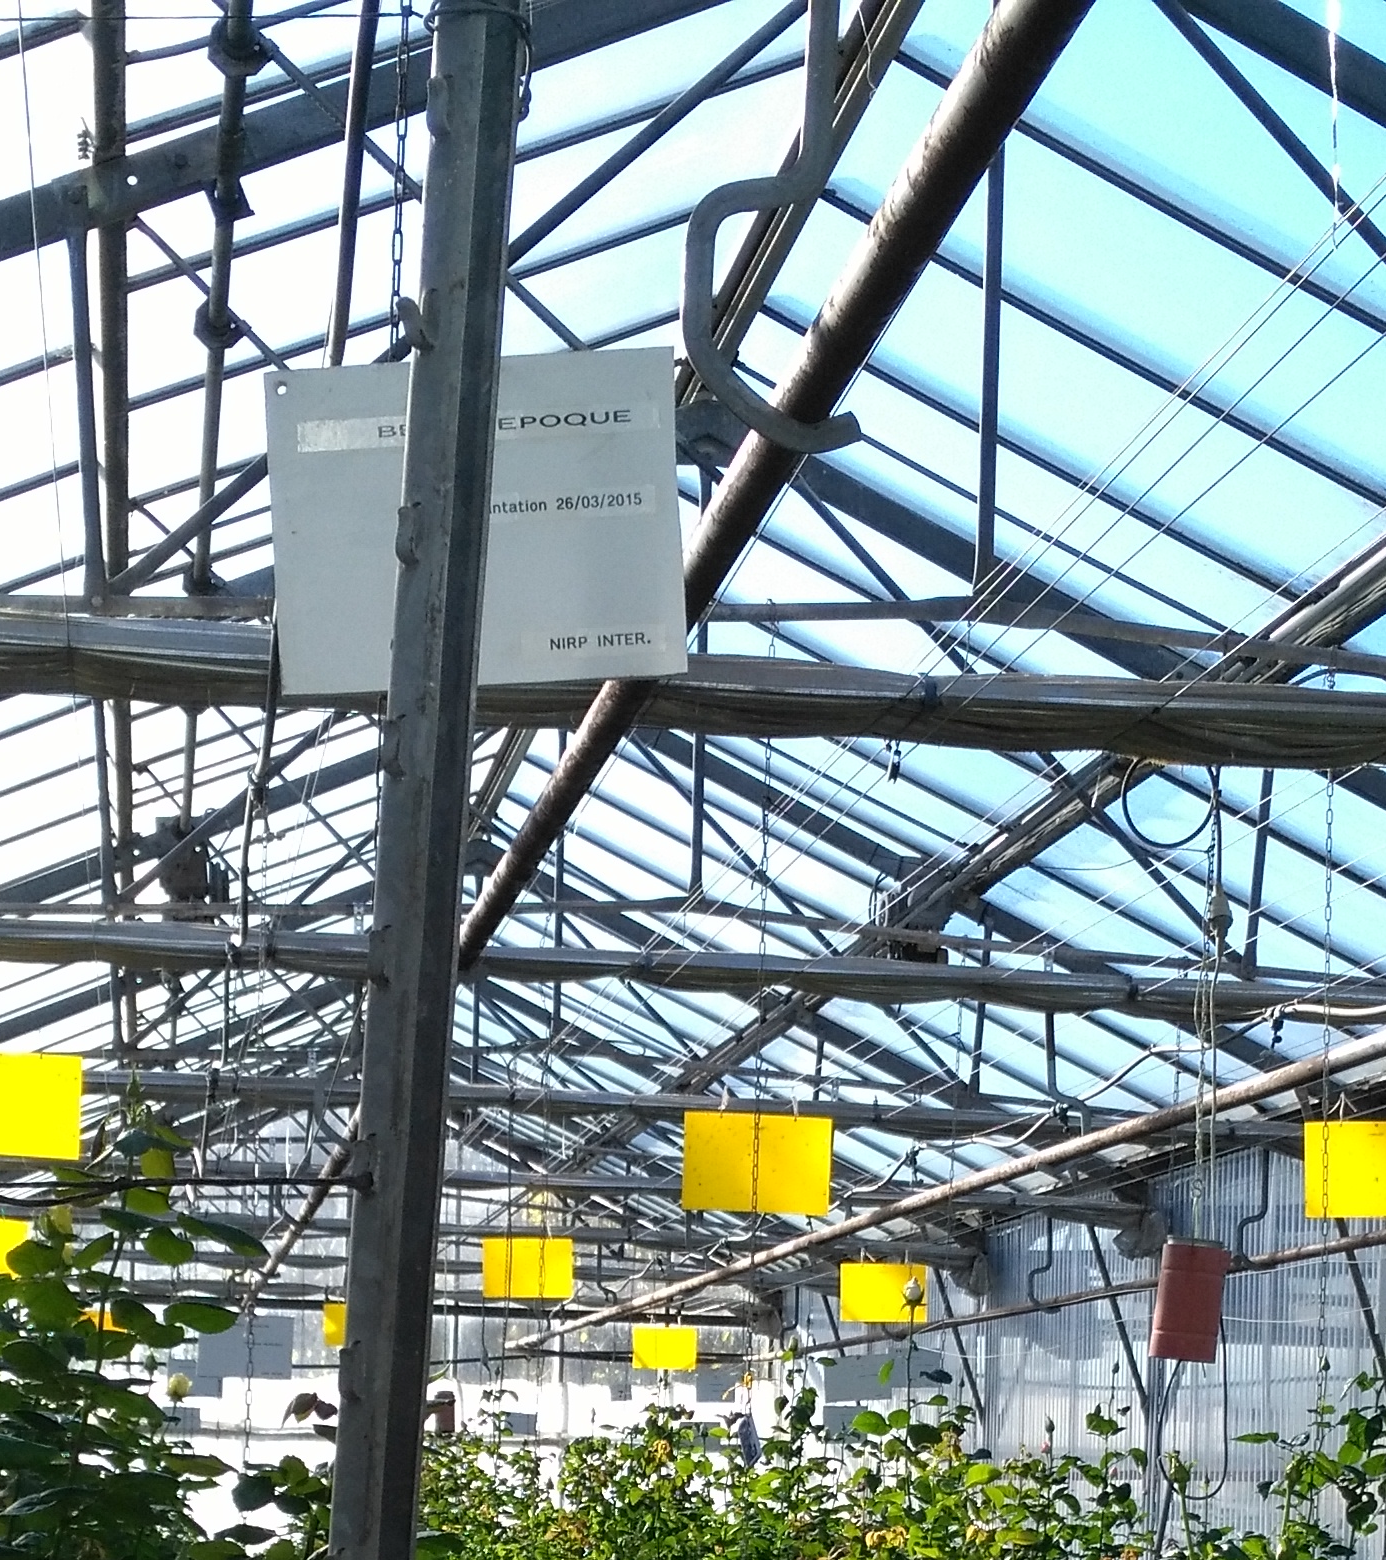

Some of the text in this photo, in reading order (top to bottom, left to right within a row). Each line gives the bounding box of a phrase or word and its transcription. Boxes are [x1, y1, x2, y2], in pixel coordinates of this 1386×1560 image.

[499, 409, 632, 429] EPOQUE
[489, 493, 642, 514] ntation 26/03/2015
[549, 633, 652, 651] NIRP INTER.
